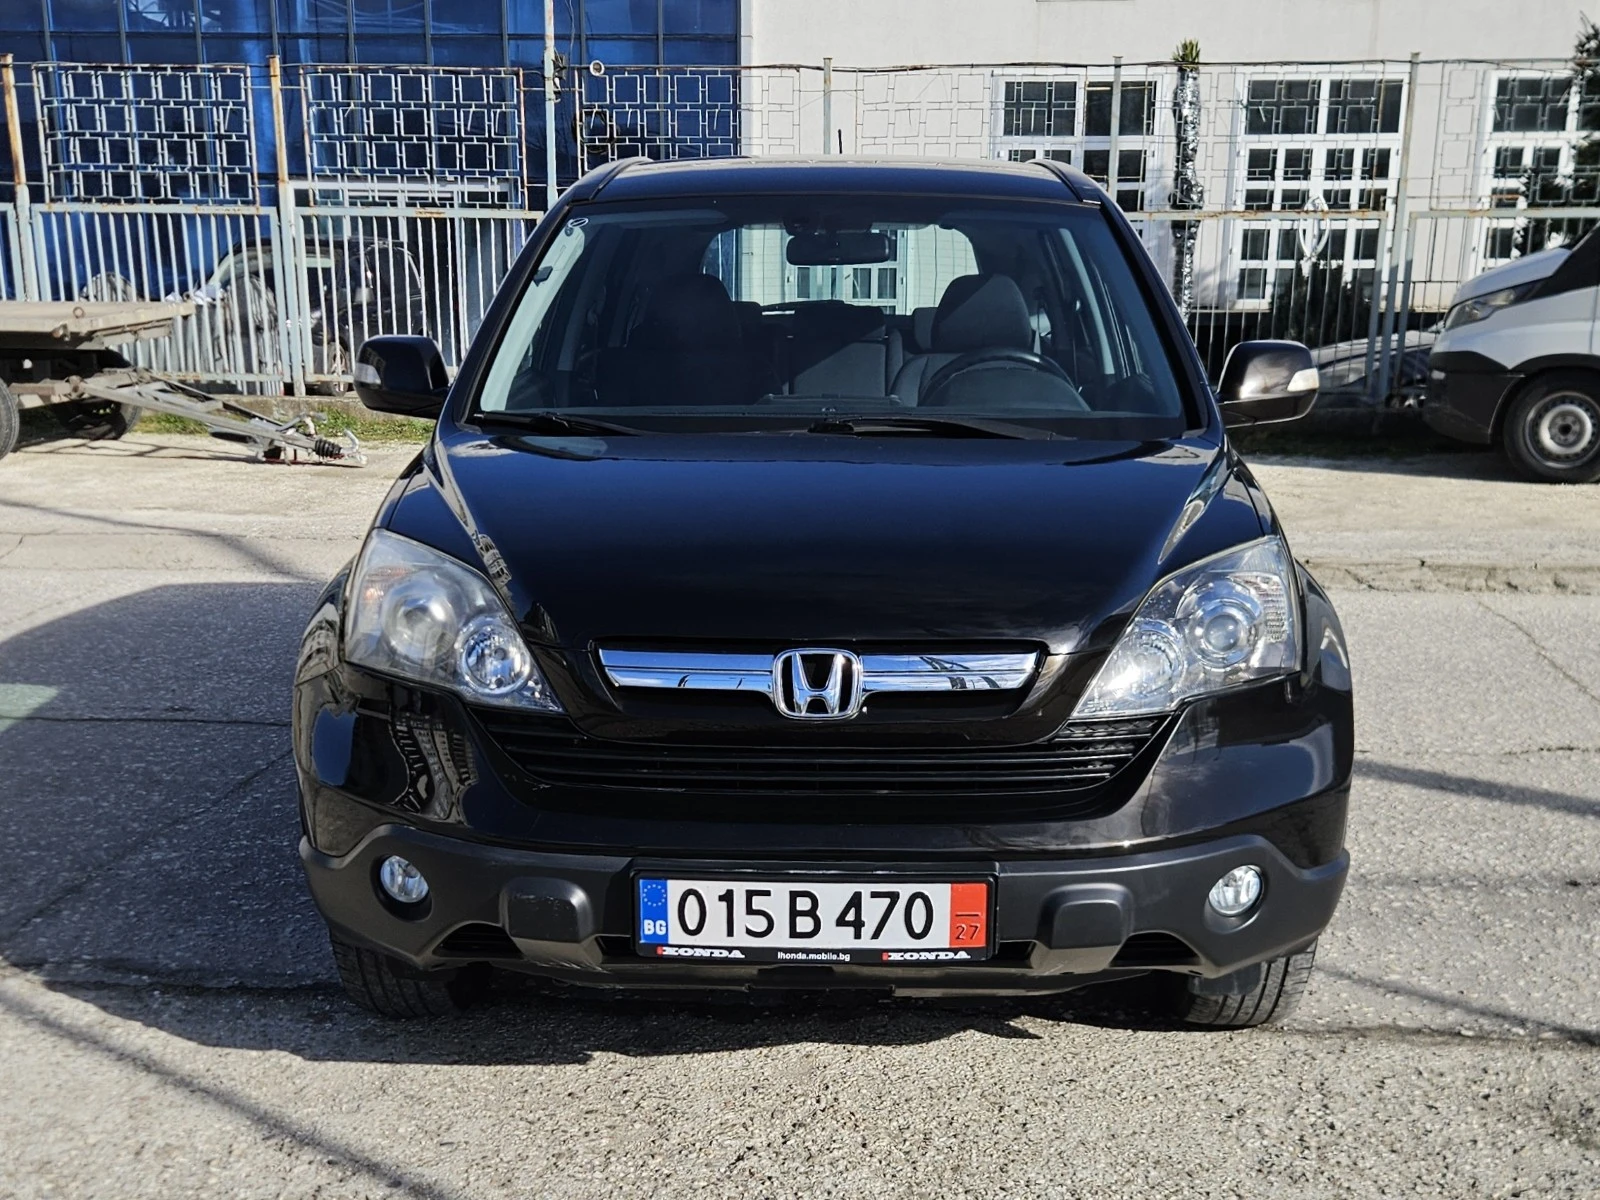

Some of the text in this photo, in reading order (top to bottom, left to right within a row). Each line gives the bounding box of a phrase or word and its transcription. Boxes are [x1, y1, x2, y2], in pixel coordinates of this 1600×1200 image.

[677, 889, 934, 940] 015 B 470
[643, 919, 667, 936] BG
[955, 923, 981, 940] 27
[662, 946, 746, 959] HONDA
[887, 950, 971, 961] HONDA
